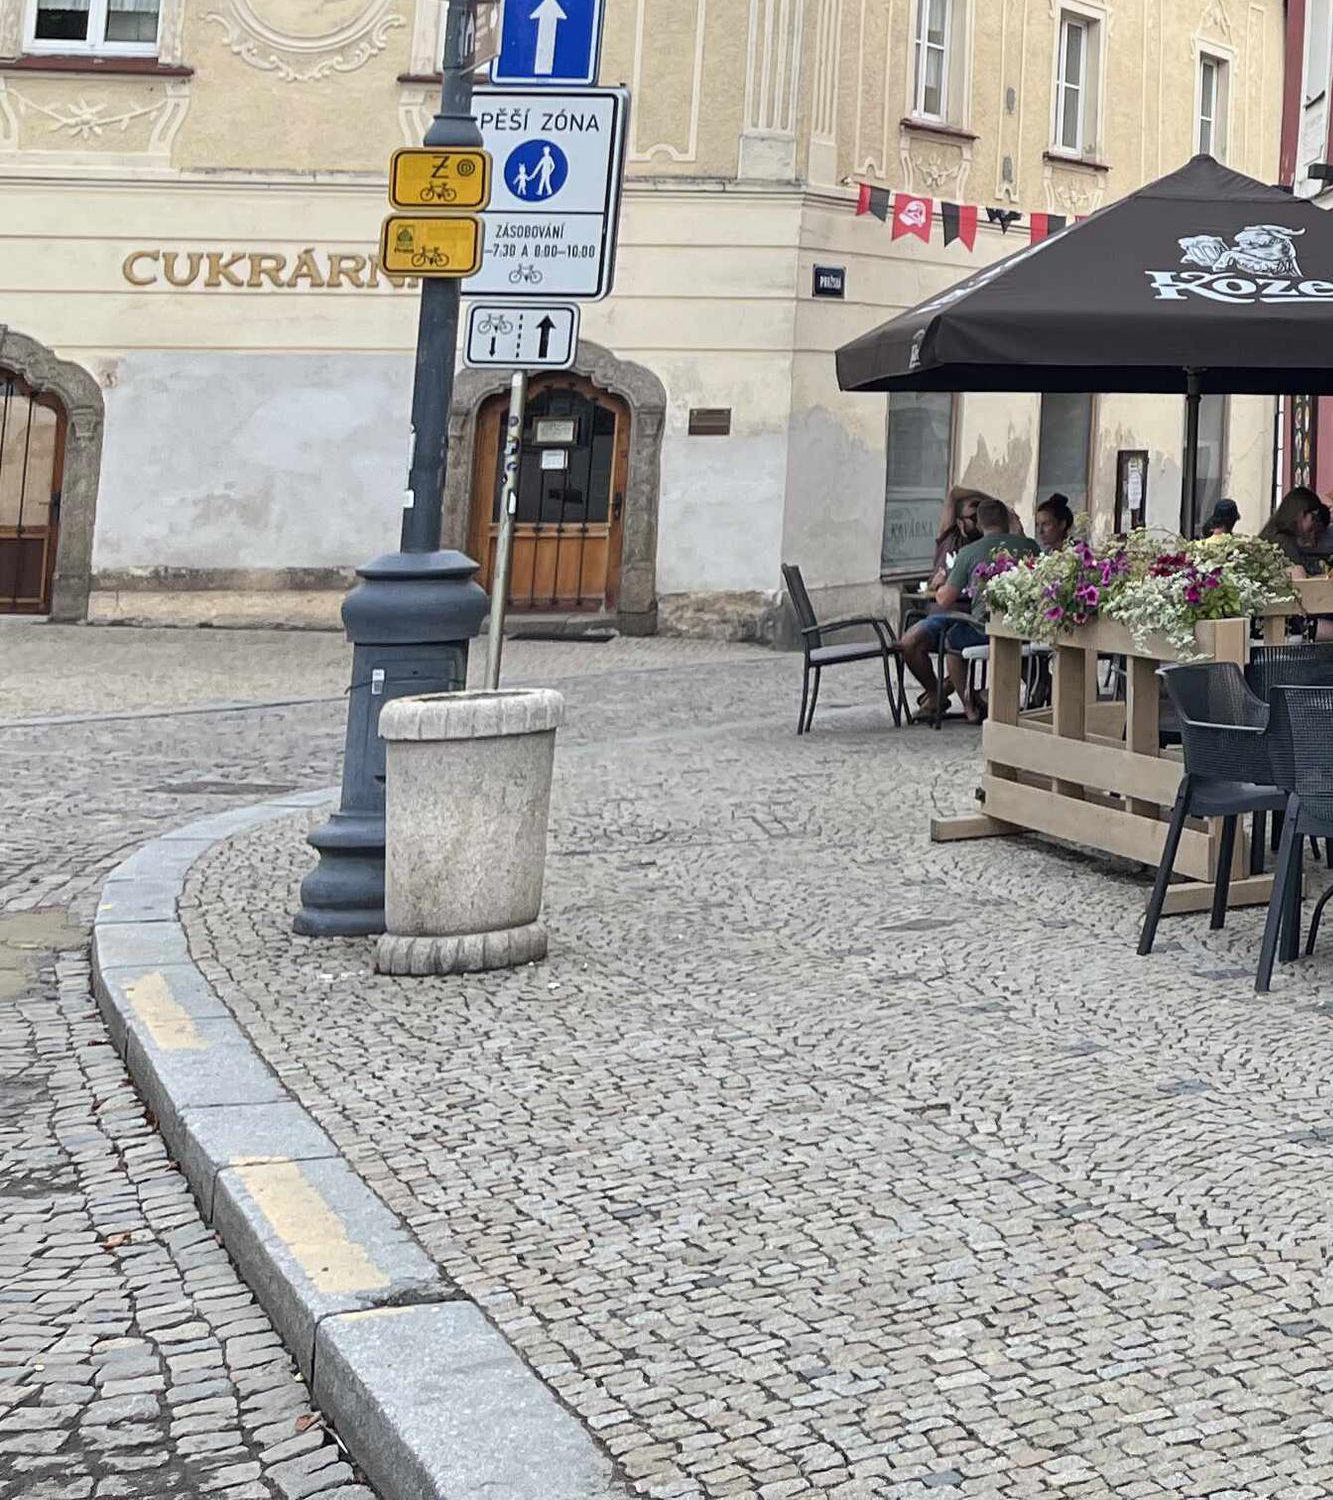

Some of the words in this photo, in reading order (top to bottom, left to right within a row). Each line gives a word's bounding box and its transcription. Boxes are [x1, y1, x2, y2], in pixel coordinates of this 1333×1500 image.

[480, 108, 531, 131] PĚŠÍ
[541, 109, 600, 132] ZÓNA
[495, 221, 566, 239] ZÁSOBOVÁNÍ
[122, 248, 420, 288] CUKRÁRN
